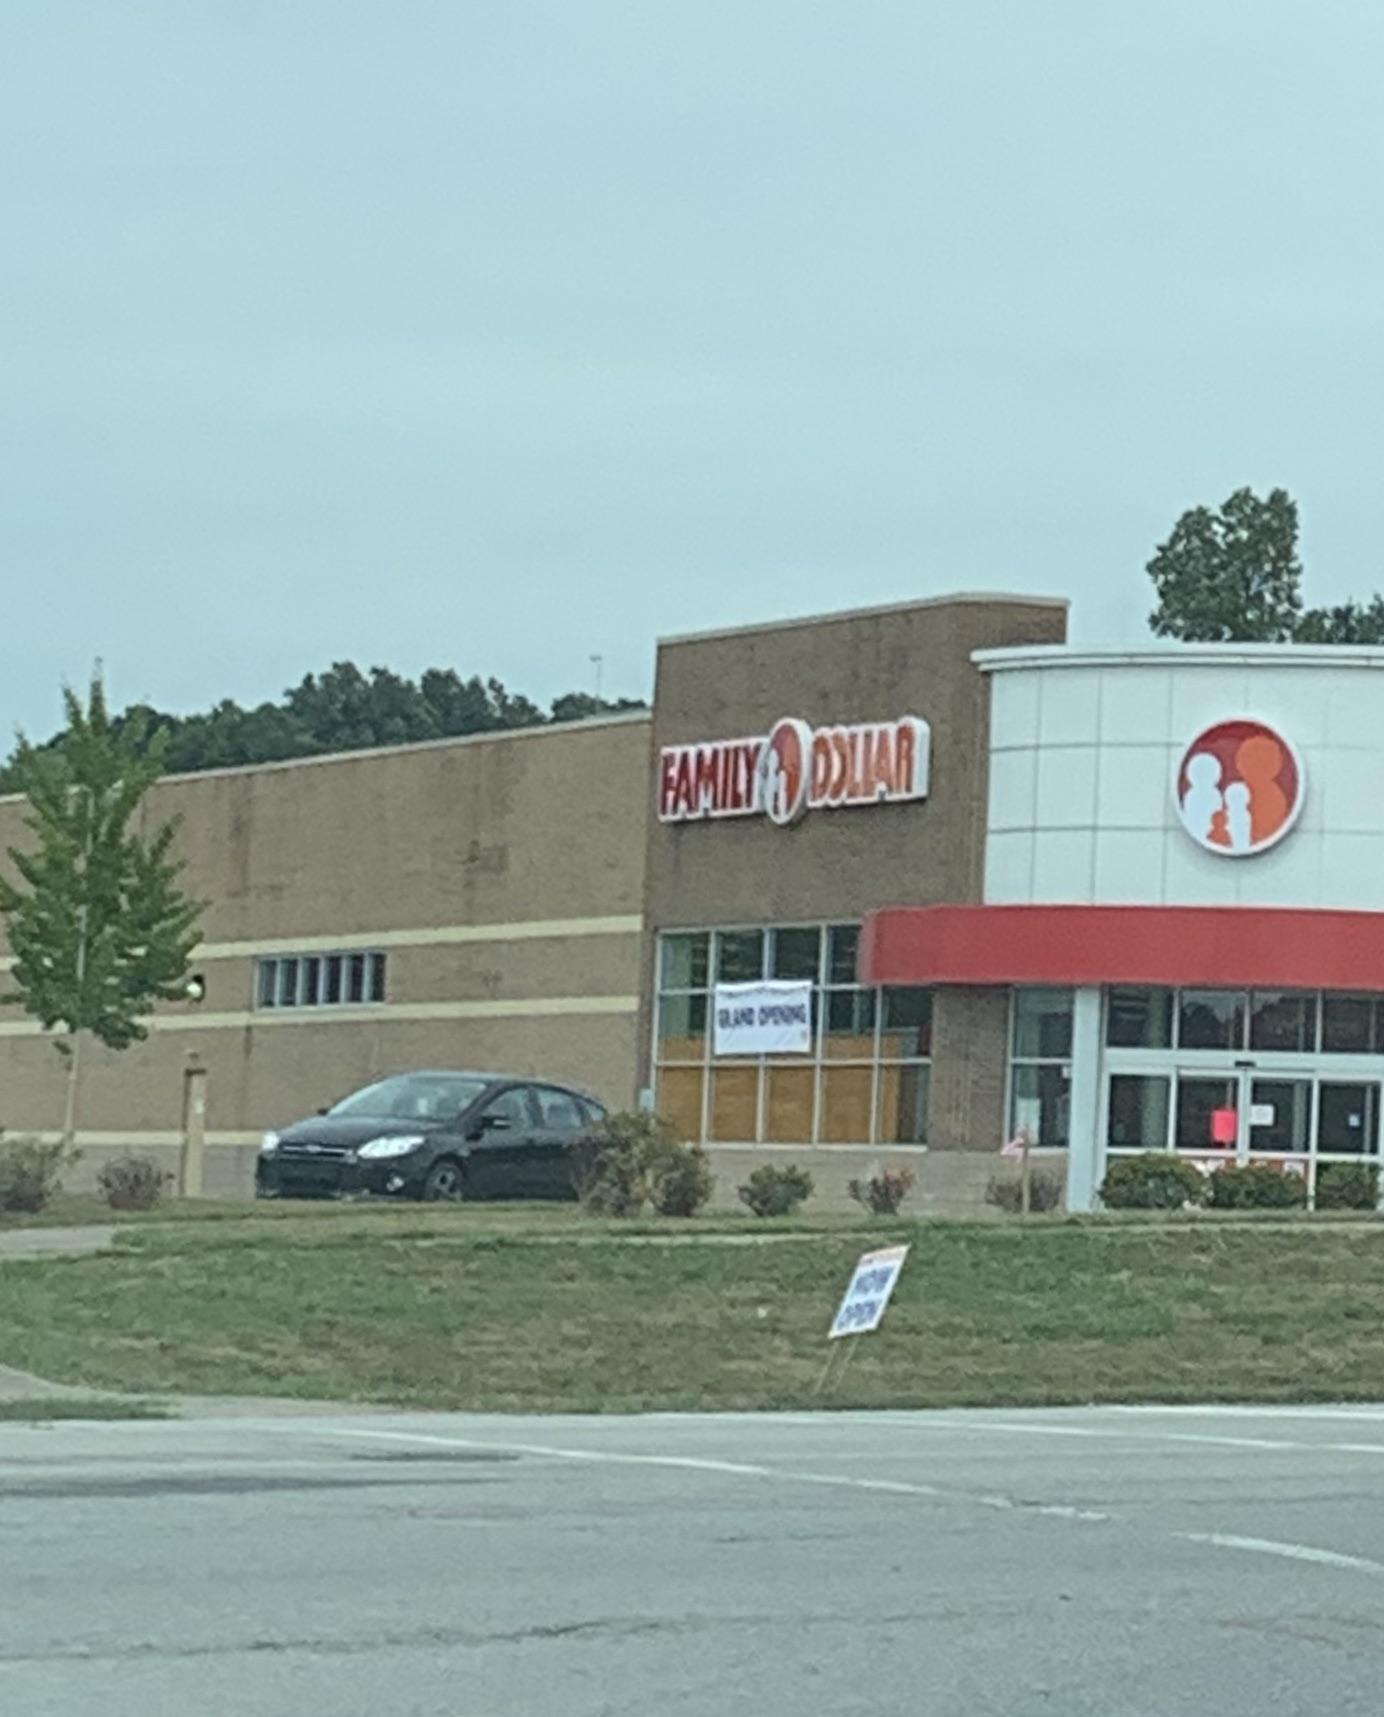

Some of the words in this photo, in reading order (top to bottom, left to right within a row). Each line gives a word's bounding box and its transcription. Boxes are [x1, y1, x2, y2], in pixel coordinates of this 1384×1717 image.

[660, 738, 765, 818] FAMILY
[808, 722, 919, 805] DOLLAR
[719, 1007, 754, 1029] GRAND
